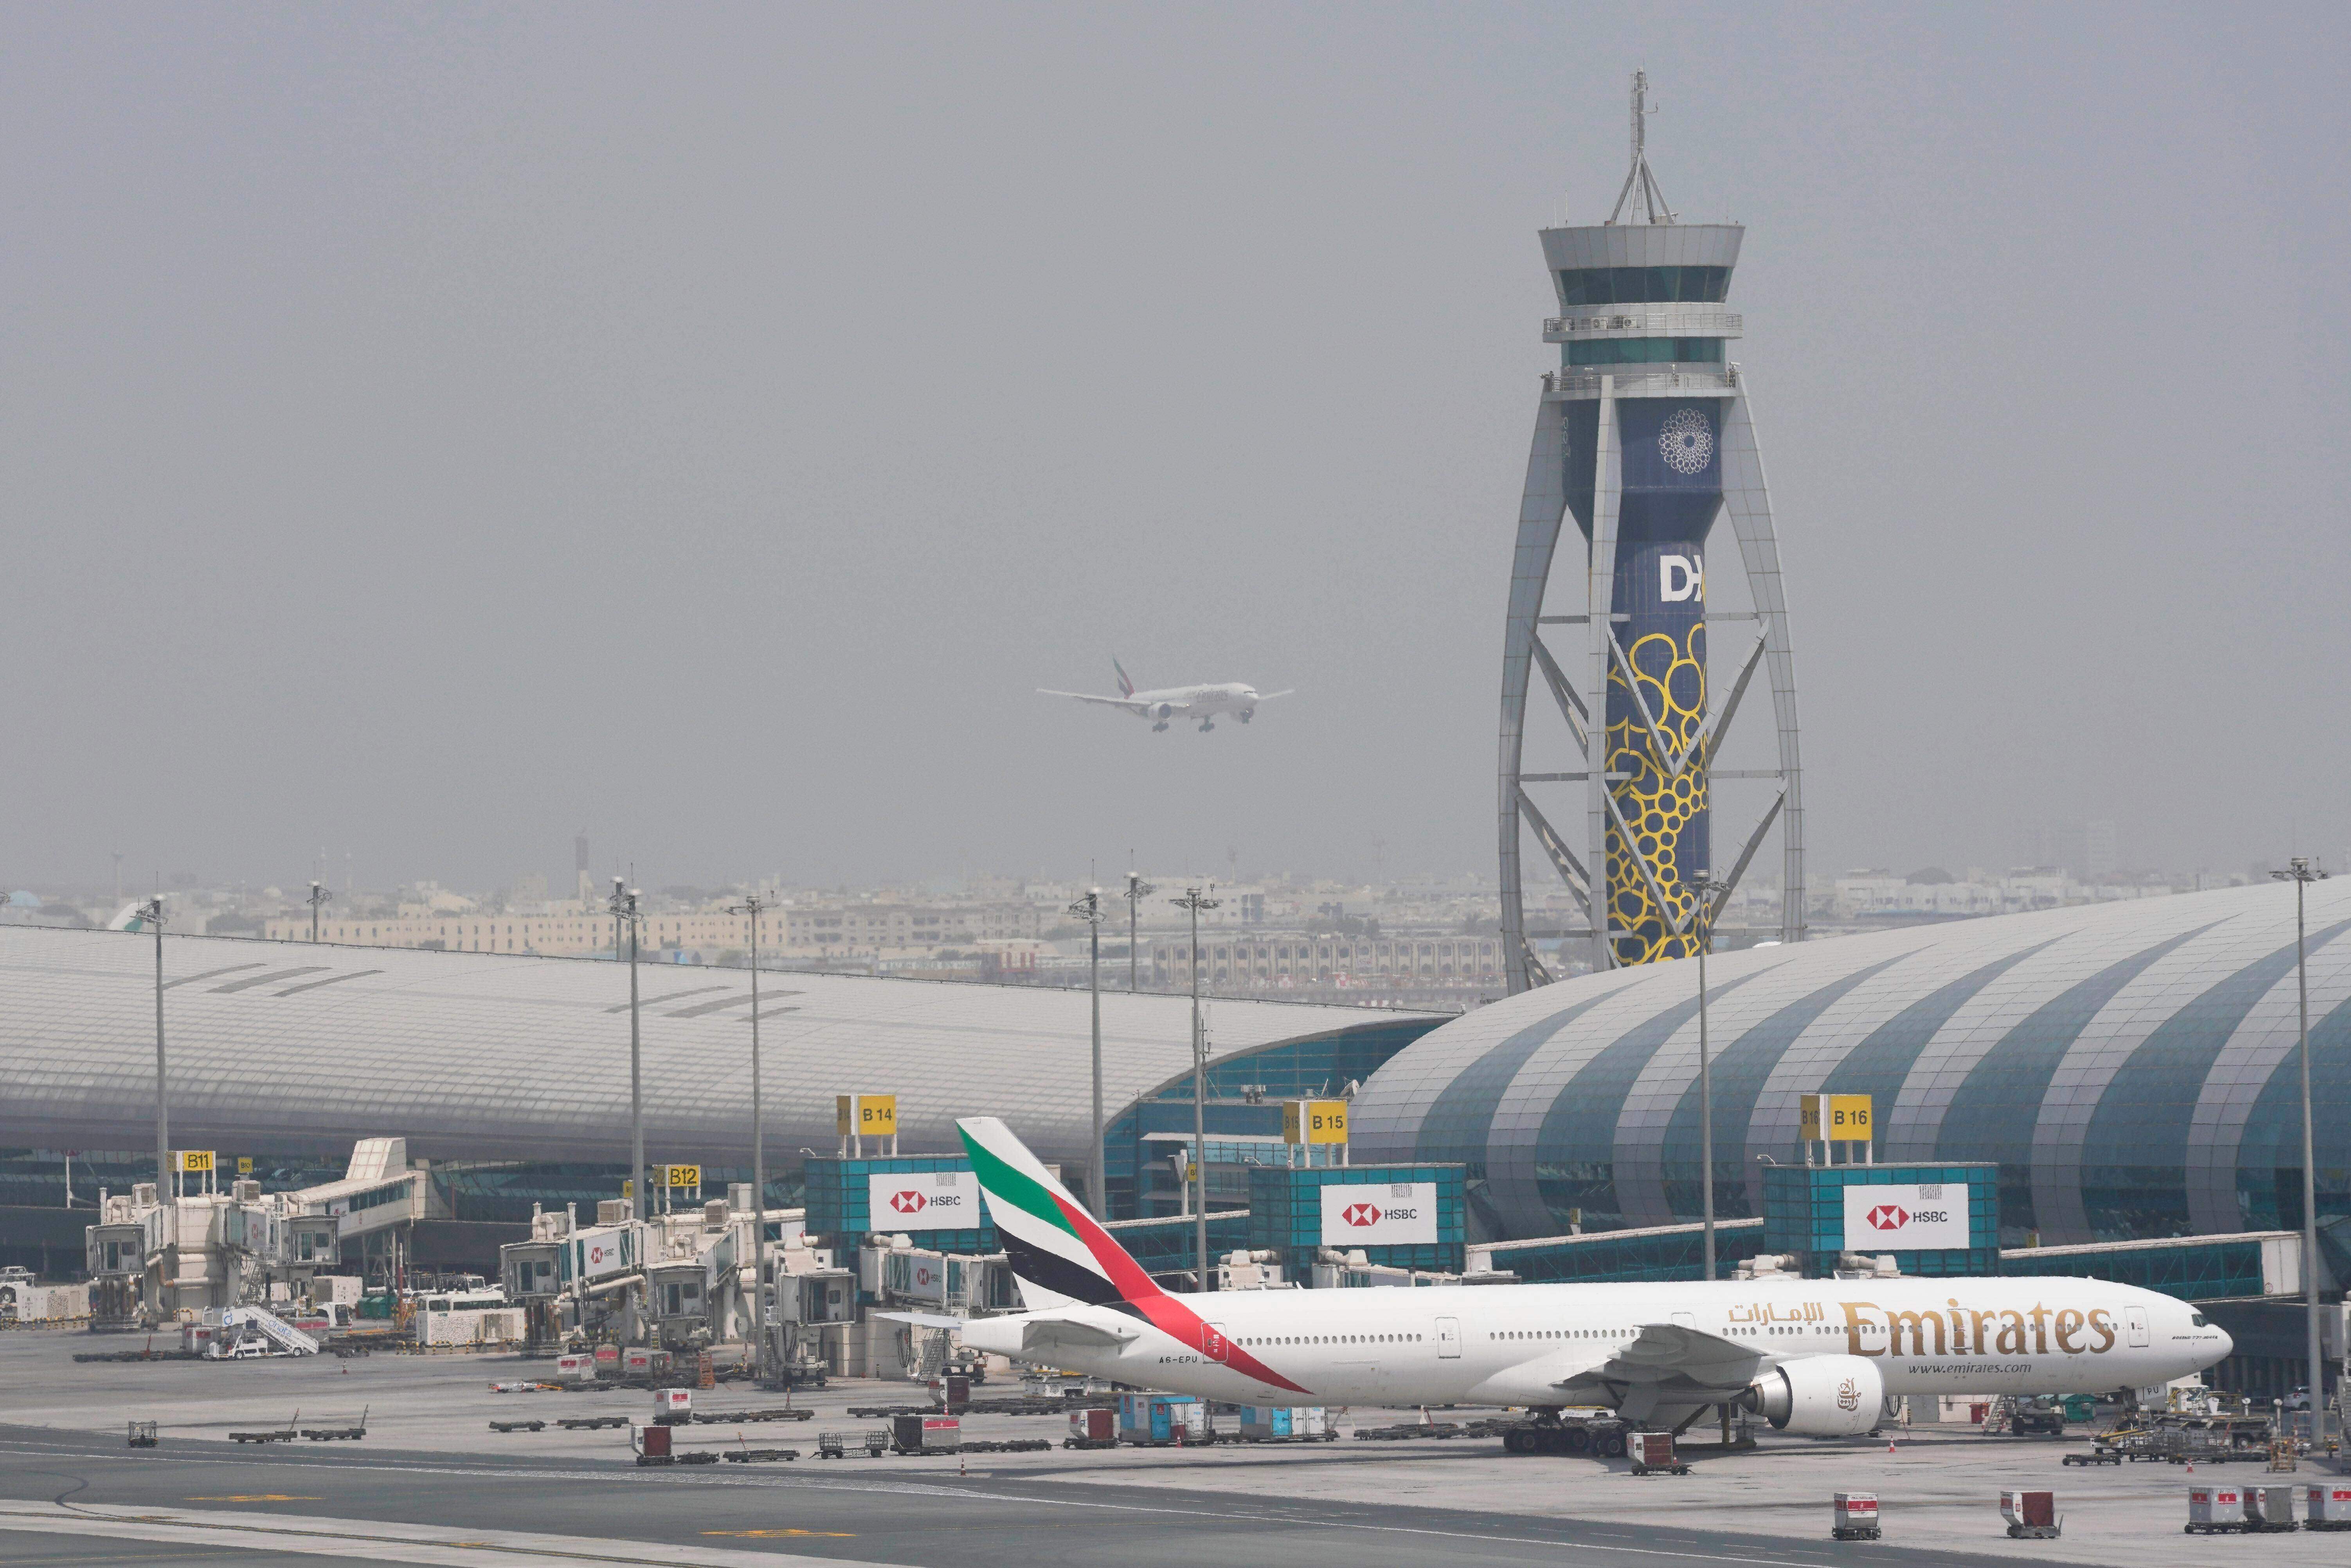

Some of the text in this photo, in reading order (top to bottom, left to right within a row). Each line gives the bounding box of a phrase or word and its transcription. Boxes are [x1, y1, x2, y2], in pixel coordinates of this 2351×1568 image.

[863, 1108, 892, 1122] B 14
[1285, 1115, 1300, 1129] B 15
[1313, 1115, 1343, 1129] B 15
[1802, 1110, 1820, 1124] B 16
[1834, 1110, 1867, 1125] B 16
[188, 1154, 209, 1168] B11
[670, 1168, 697, 1185] B12
[930, 1196, 961, 1207] HSBC
[1385, 1208, 1417, 1219] HSBC
[1913, 1211, 1948, 1223] HSBC
[1728, 1302, 1824, 1326] الإمارات
[268, 1320, 292, 1337] dnata
[1837, 1298, 2116, 1356] Emirates
[1159, 1356, 1197, 1364] A6-EPU
[1908, 1362, 2032, 1374] www.emirates.com
[2147, 1386, 2159, 1395] PU
